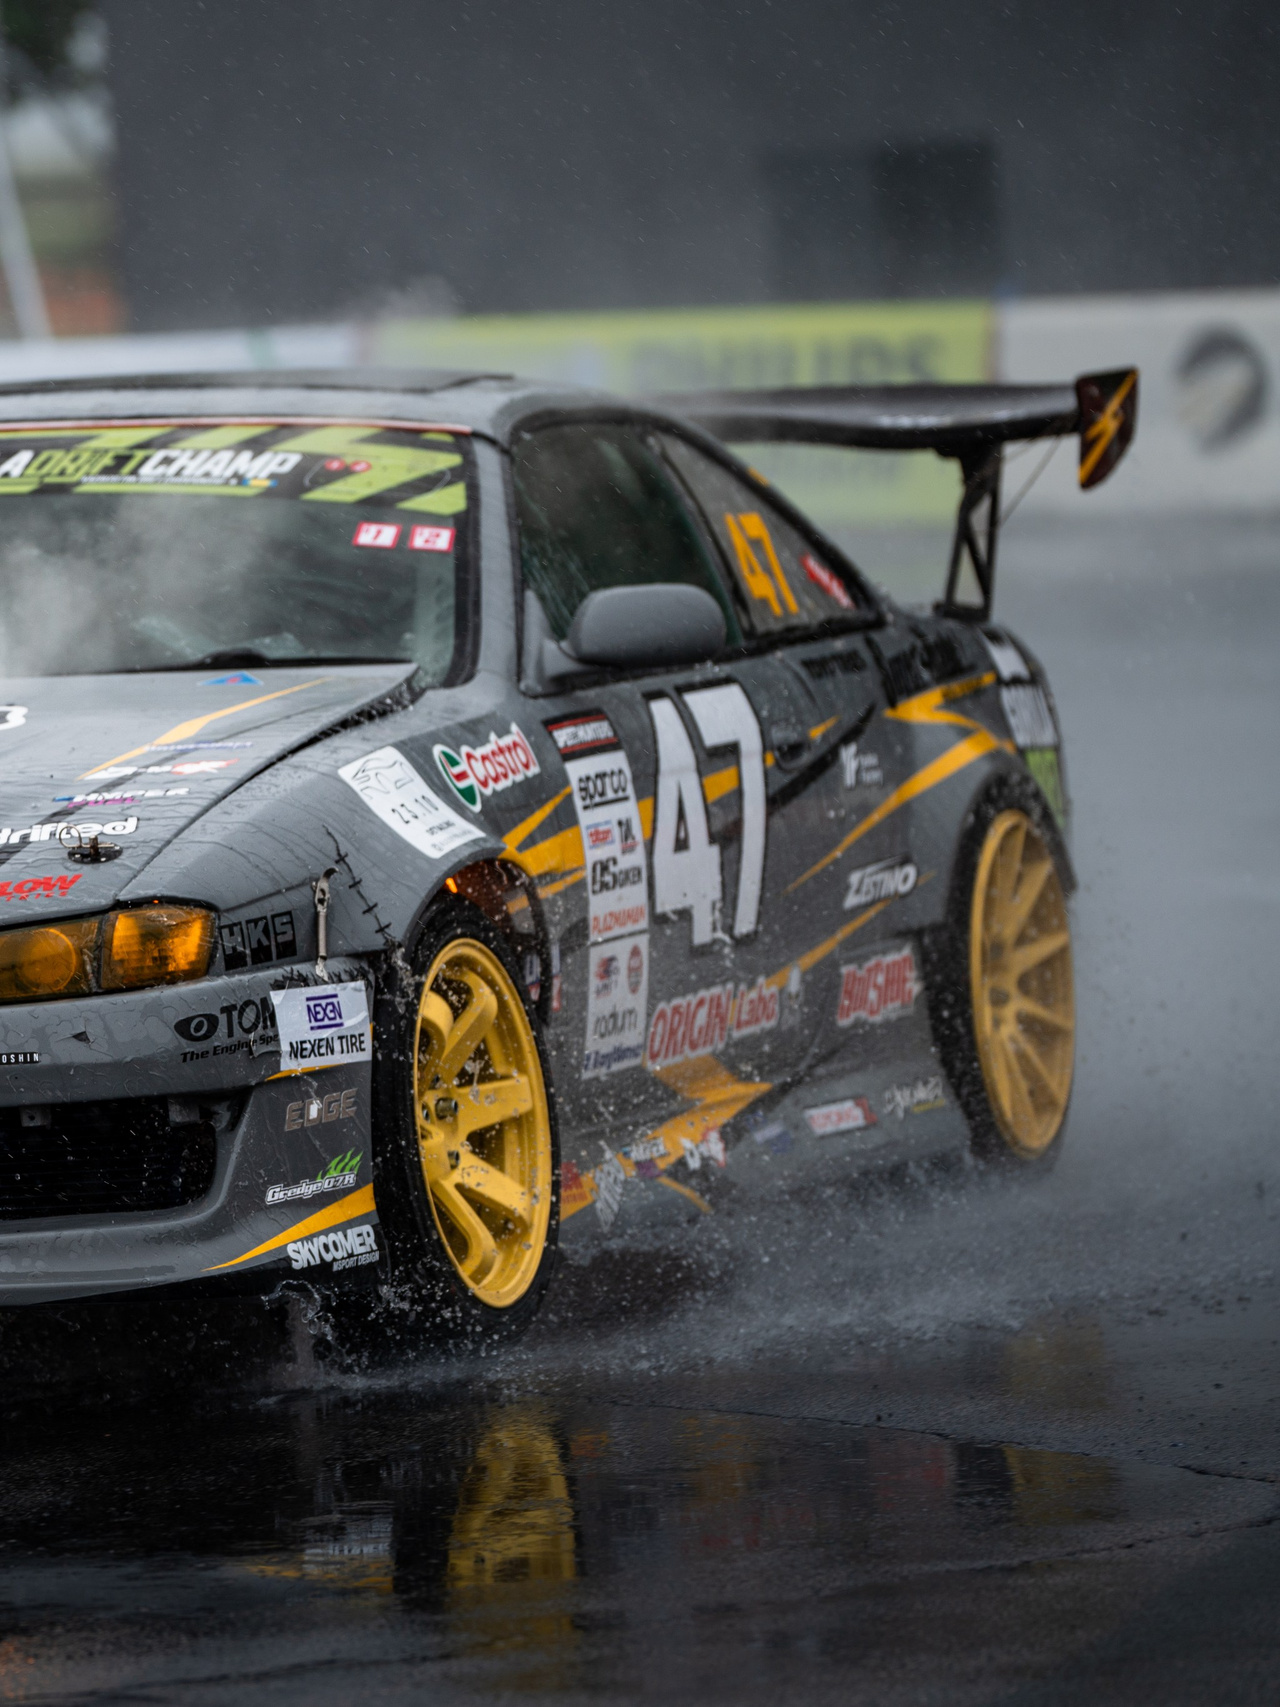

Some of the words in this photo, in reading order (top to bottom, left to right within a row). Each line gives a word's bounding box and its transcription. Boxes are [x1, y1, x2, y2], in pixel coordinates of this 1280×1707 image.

[725, 512, 799, 617] 47
[464, 729, 537, 790] Castrol
[578, 768, 628, 802] sparco
[651, 684, 763, 948] 47
[843, 860, 918, 911] ZESTINO
[221, 912, 296, 964] HKS
[306, 1000, 343, 1024] NEXEN
[648, 986, 733, 1066] ORIGIN
[181, 1050, 209, 1063] The
[213, 1039, 258, 1057] Engine
[289, 1038, 335, 1060] NEXEN
[337, 1032, 367, 1055] TIRE
[285, 1088, 358, 1132] EDGE
[265, 1179, 323, 1205] Gredge
[286, 1224, 379, 1271] SKYCOMER
